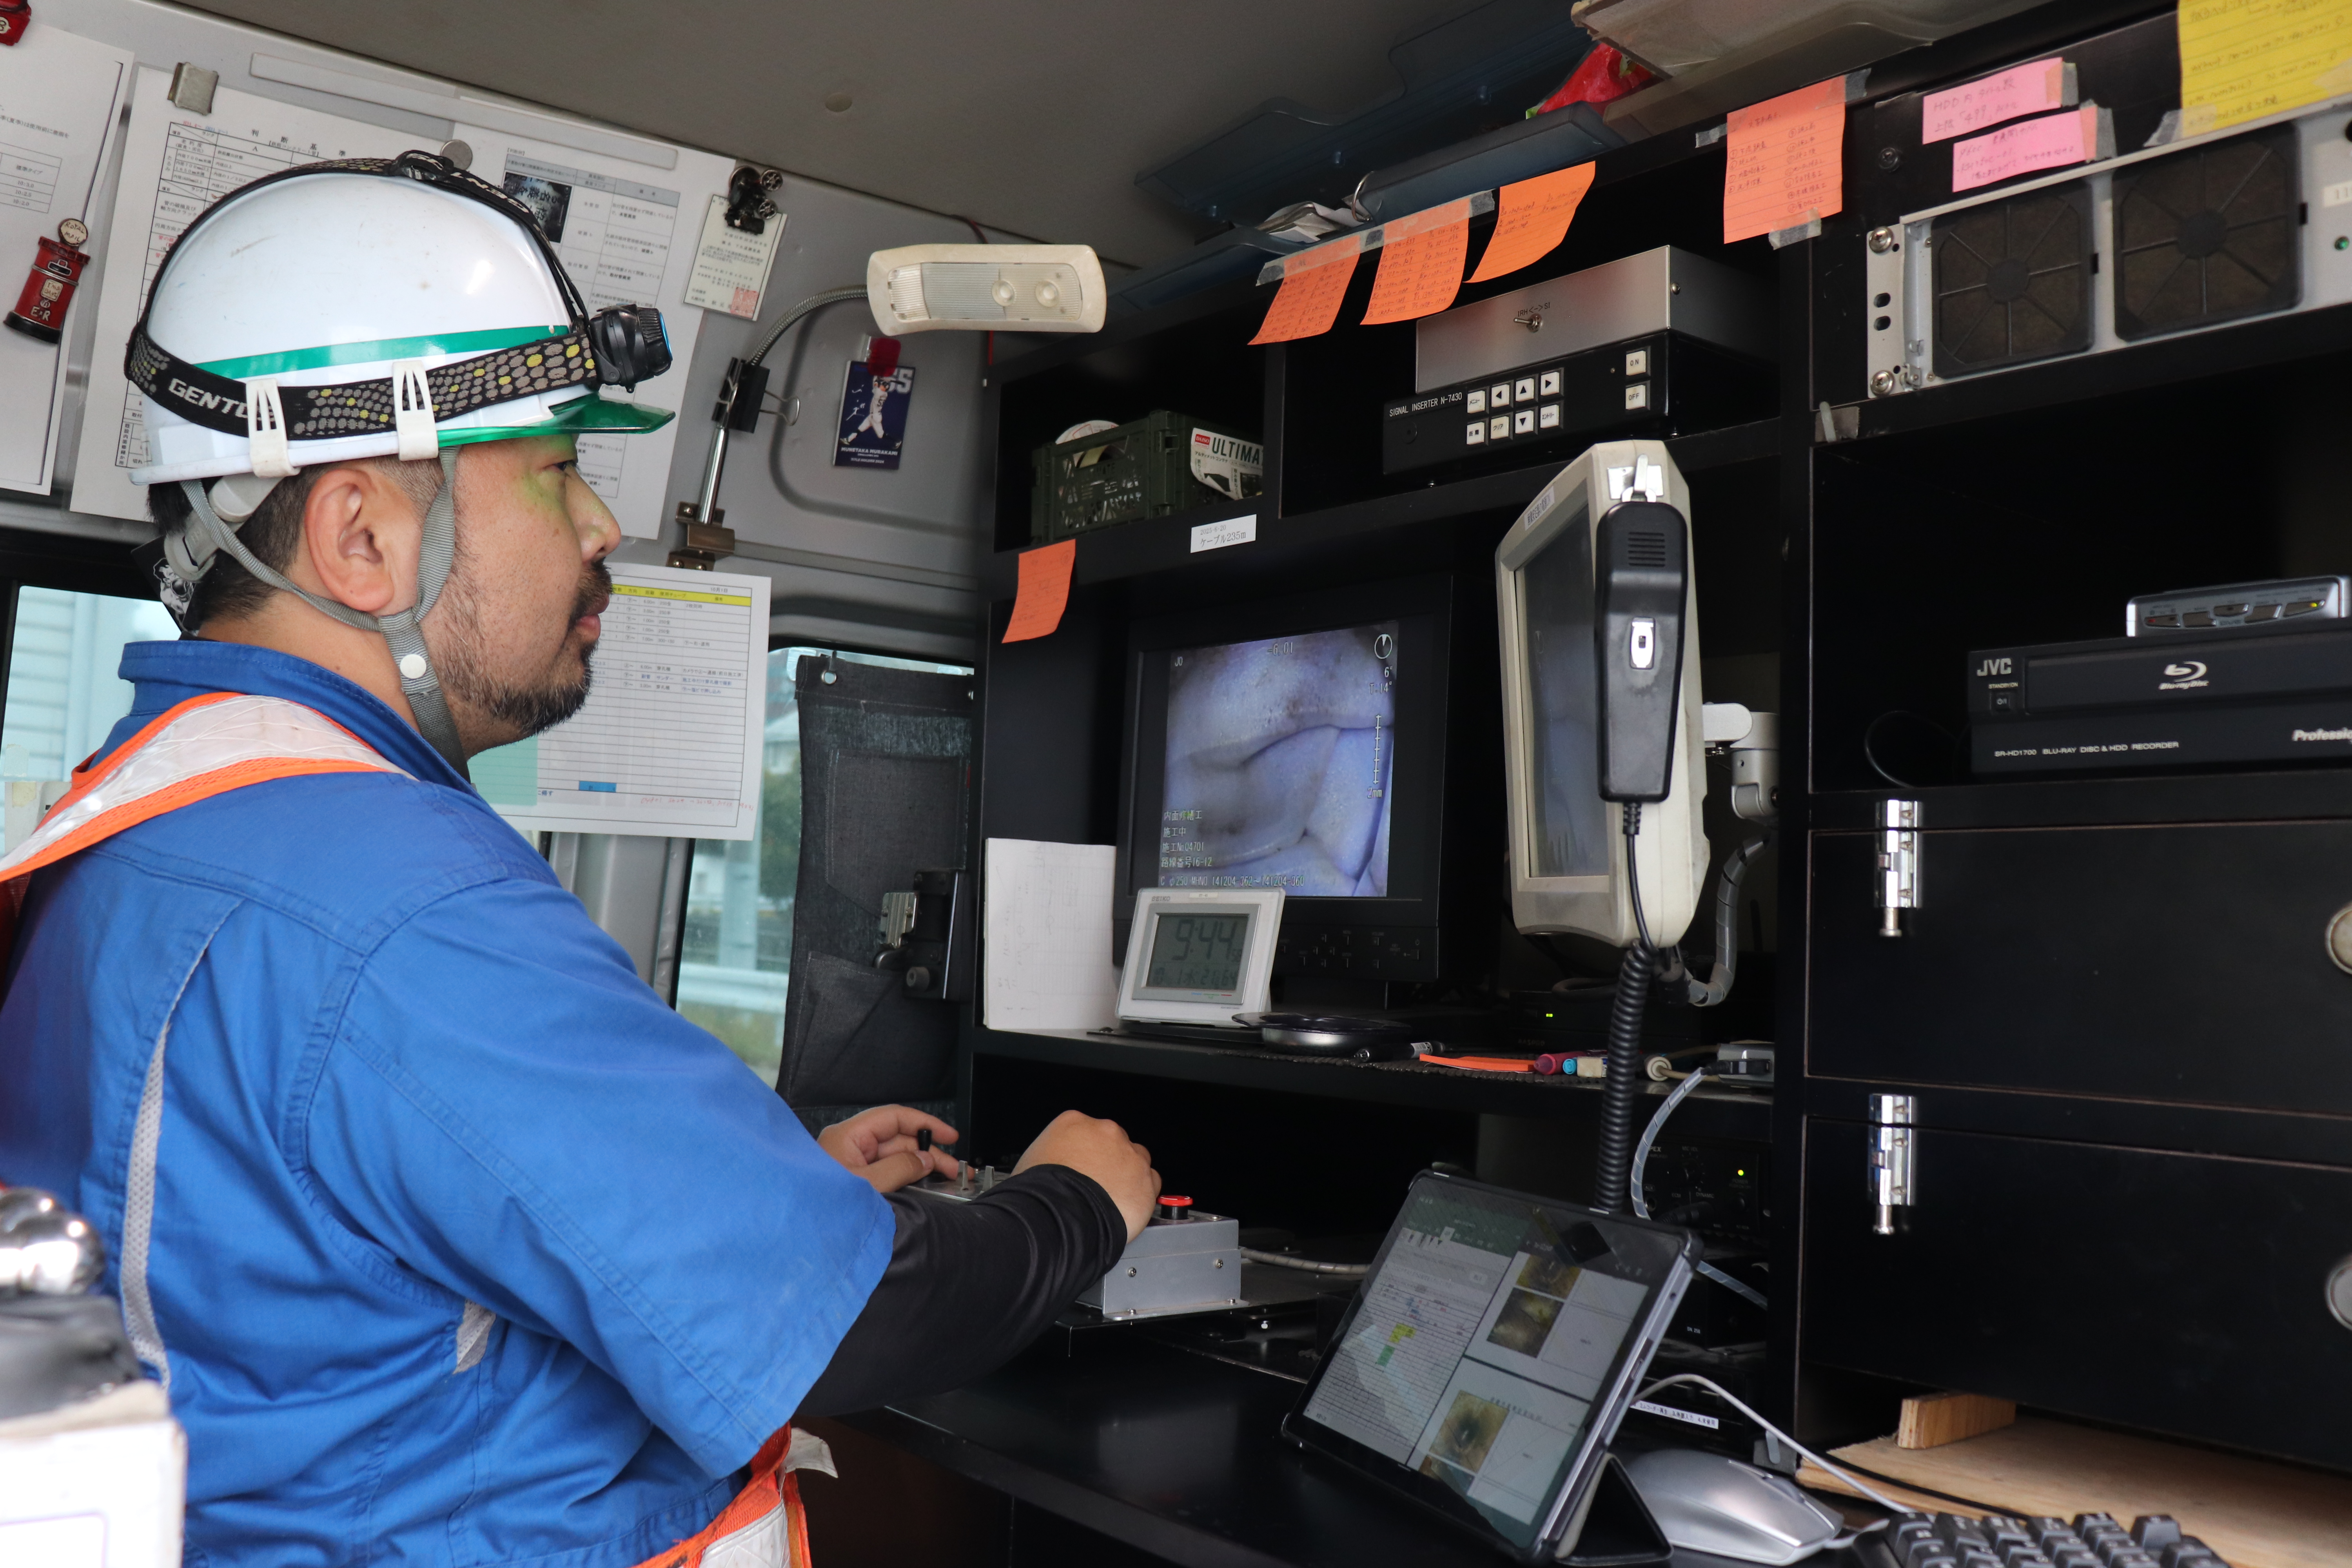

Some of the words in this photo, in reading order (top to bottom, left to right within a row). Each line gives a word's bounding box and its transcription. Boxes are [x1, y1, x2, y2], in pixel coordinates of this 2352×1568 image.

[1389, 406, 1408, 417] SIGNAL
[1412, 398, 1438, 411] INSERTER
[1441, 392, 1463, 404] N-7430
[1212, 437, 1263, 465] ULTIMA
[1201, 531, 1246, 548] ケーブル235m
[1976, 658, 2011, 677] JVC
[2131, 741, 2179, 750] RECORDER
[1367, 787, 1382, 799] 2mm
[1164, 810, 1202, 822] 内面修繕工
[1163, 827, 1186, 838] 施工中
[1161, 857, 1212, 869] 路線番号16-12
[1171, 920, 1237, 960] 9:44
